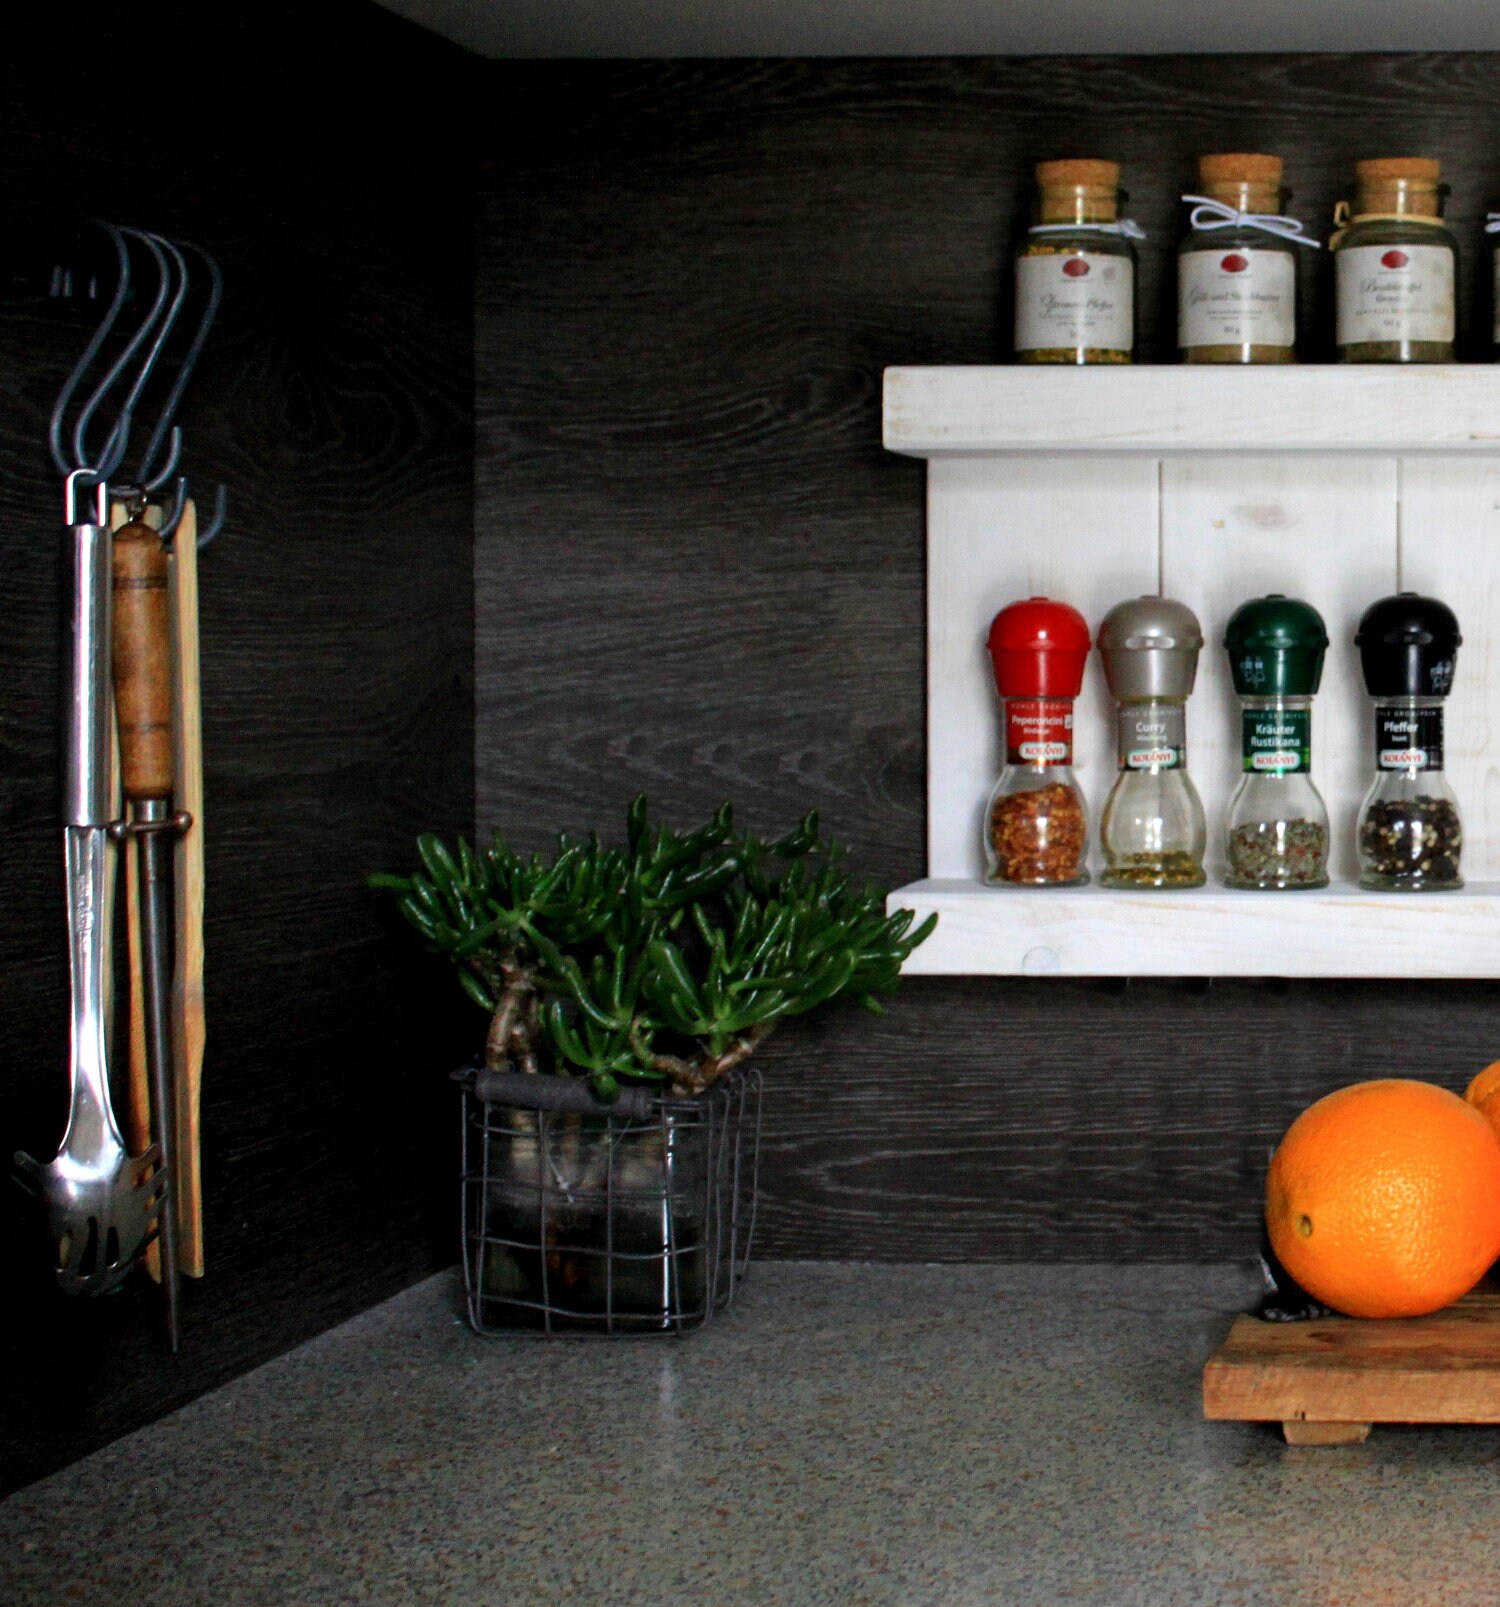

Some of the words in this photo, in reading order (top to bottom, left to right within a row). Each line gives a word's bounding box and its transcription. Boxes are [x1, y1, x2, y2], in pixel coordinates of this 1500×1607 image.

[1012, 715, 1064, 726] Peperoncini
[1135, 722, 1166, 734] Curry
[1256, 724, 1295, 735] Kräuter
[1383, 721, 1420, 733] Pfeffer
[1250, 736, 1301, 747] Rustikana
[1383, 751, 1422, 762] KOTÁNYI
